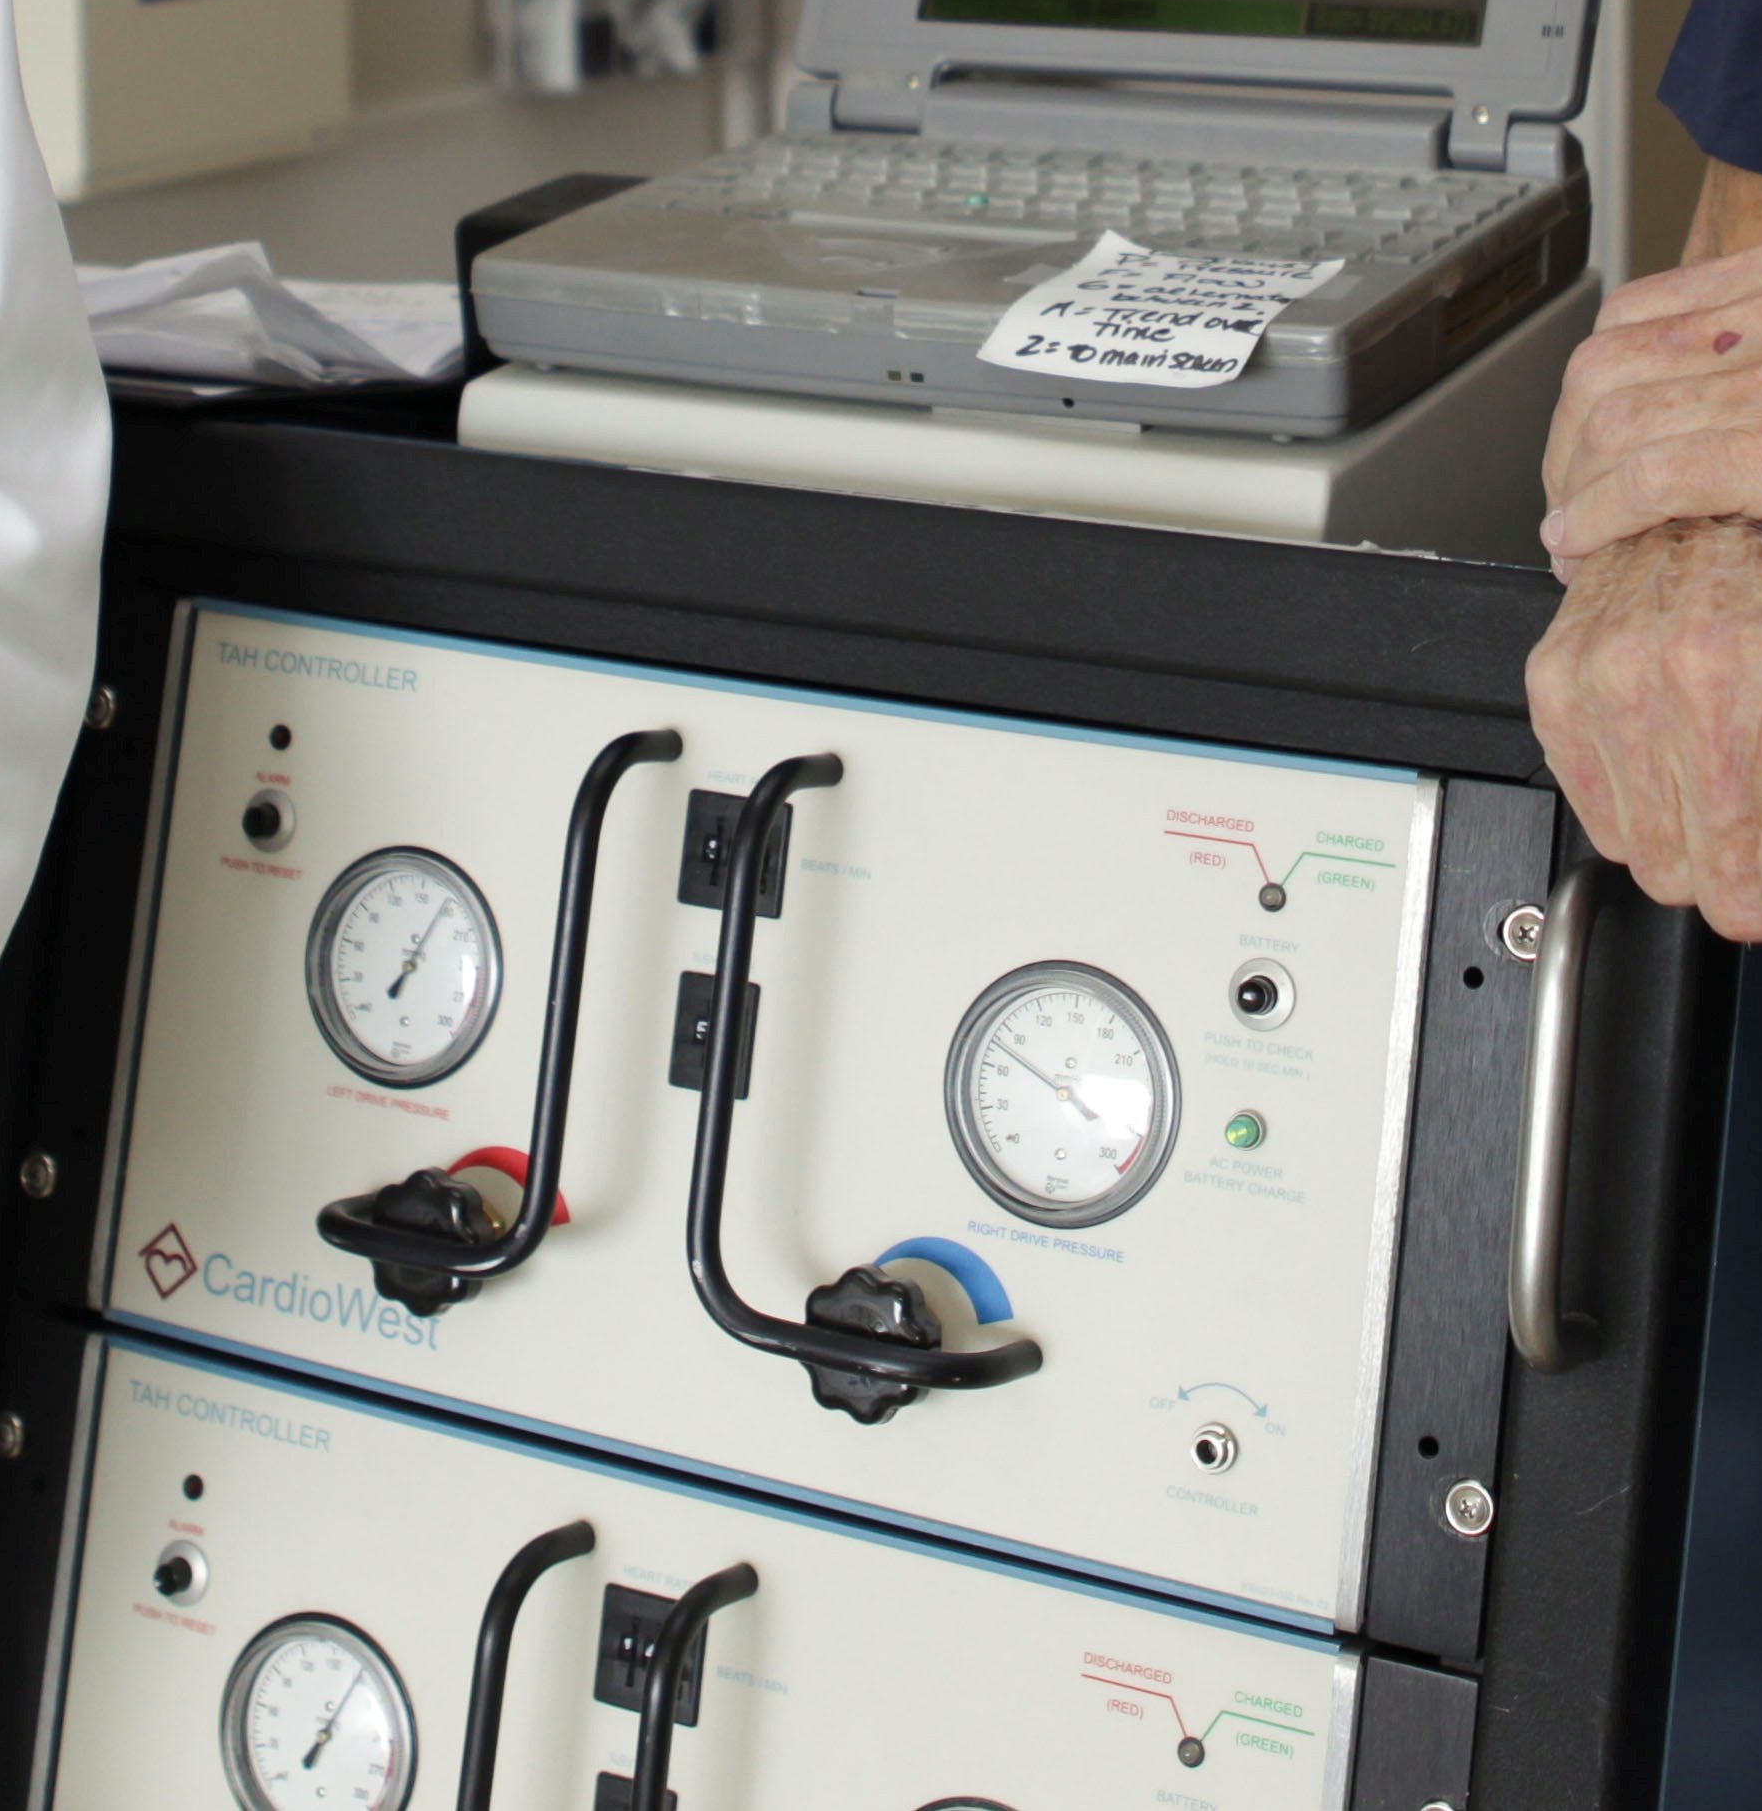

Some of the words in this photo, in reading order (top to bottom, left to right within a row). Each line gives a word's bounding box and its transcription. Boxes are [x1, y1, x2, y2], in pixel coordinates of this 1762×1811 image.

[217, 641, 258, 668] TAH
[263, 649, 419, 693] CONTROLLER
[1165, 808, 1256, 834] DISCHARGED
[1315, 830, 1386, 853] CHARGED
[1189, 851, 1228, 870] (RED)
[1316, 869, 1376, 893] (GREEN)
[1238, 933, 1302, 955] BATTERY
[1035, 1015, 1053, 1028] 120
[1067, 1012, 1085, 1025] 150
[1013, 1033, 1027, 1046] 90
[1097, 1027, 1115, 1040] 180
[996, 1065, 1009, 1077] 60
[1114, 1053, 1134, 1067] 210
[996, 1099, 1009, 1111] 30
[1098, 1146, 1117, 1160] 300
[1209, 1155, 1230, 1171] AC
[1231, 1158, 1285, 1181] POWER
[1183, 1169, 1245, 1192] BATTERY
[1246, 1181, 1307, 1205] CHARGE
[966, 1218, 1008, 1239] RIGHT
[1009, 1225, 1050, 1249] DRIVE
[1052, 1235, 1126, 1264] PRESSURE
[202, 1252, 442, 1351] CardioWest
[1148, 1395, 1177, 1413] OFF
[129, 1378, 171, 1411] TAH
[175, 1392, 332, 1454] CONTROLLER
[1263, 1420, 1287, 1438] ON
[1165, 1484, 1260, 1518] CONTROLLER
[1081, 1650, 1174, 1686] DISCHARGED
[1106, 1697, 1145, 1721] (RED)
[1233, 1689, 1304, 1719] CHARGED
[1235, 1732, 1295, 1760] (GREEN)
